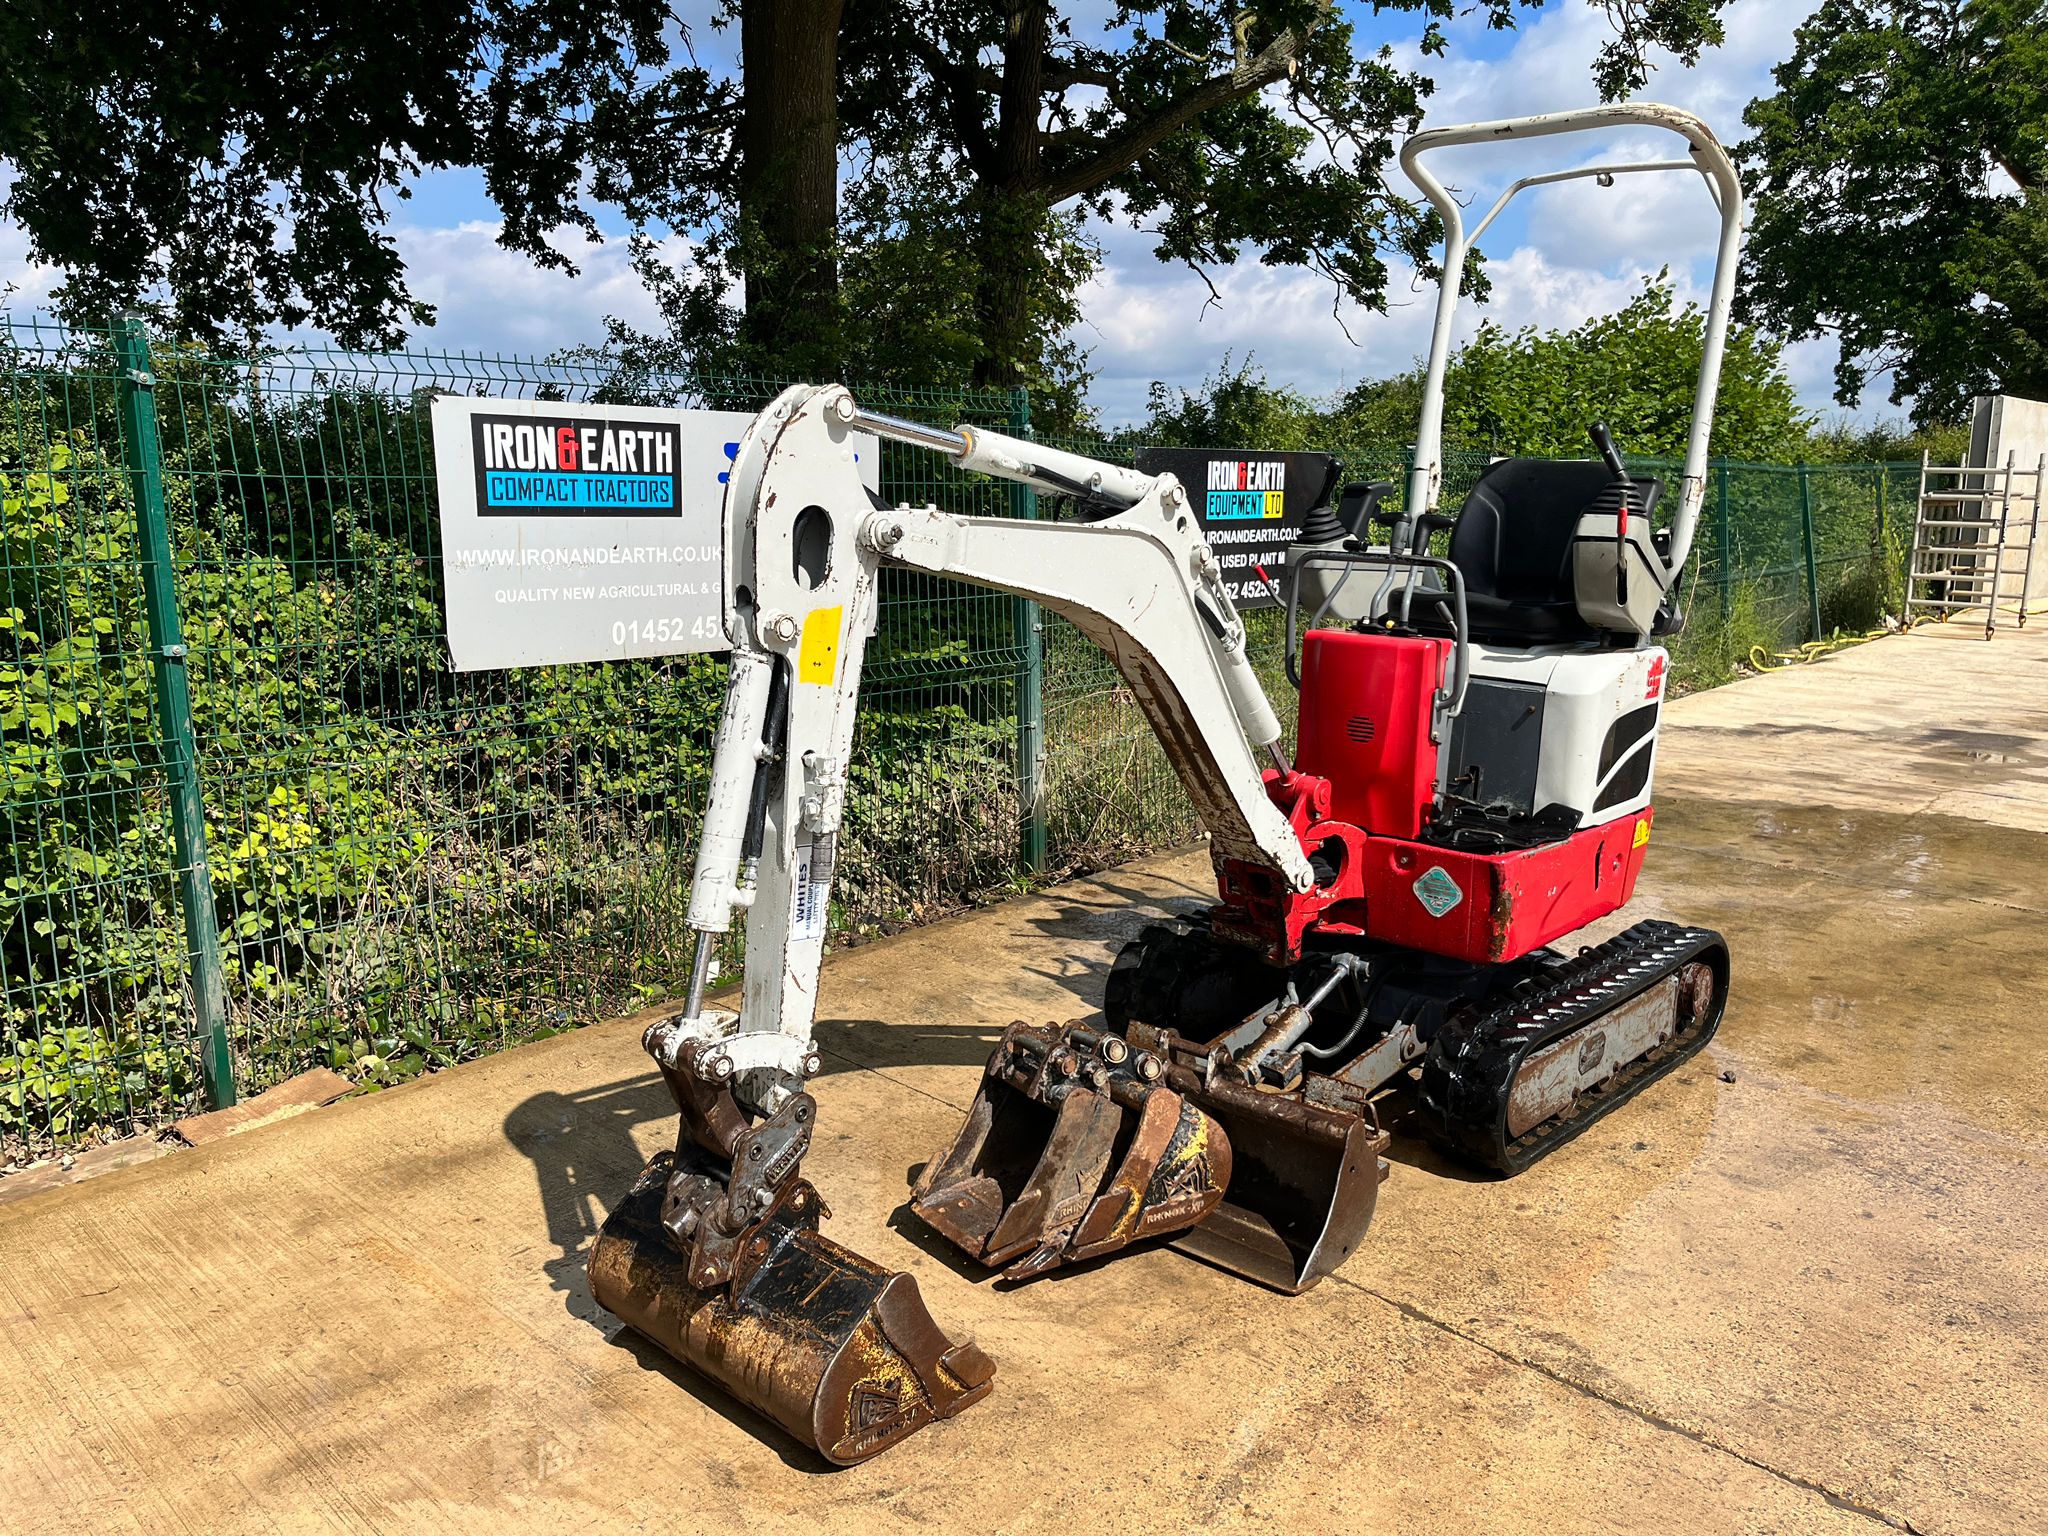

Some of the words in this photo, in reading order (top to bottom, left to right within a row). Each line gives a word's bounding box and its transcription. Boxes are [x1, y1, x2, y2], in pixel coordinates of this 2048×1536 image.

[492, 478, 578, 502] COMPACT
[584, 476, 670, 504] TRACTORS
[1209, 494, 1262, 517] EQUIPMENT
[1265, 494, 1282, 516] LTD
[456, 545, 722, 568] WWW.IRONANDEARTH.CO.UK
[1221, 553, 1247, 568] USED
[494, 588, 560, 604] QUALITY
[562, 586, 596, 601] NEW
[598, 583, 698, 600] AGRICULTURAL
[700, 582, 709, 594] &
[611, 618, 684, 646] 01452
[796, 864, 807, 923] WHITES
